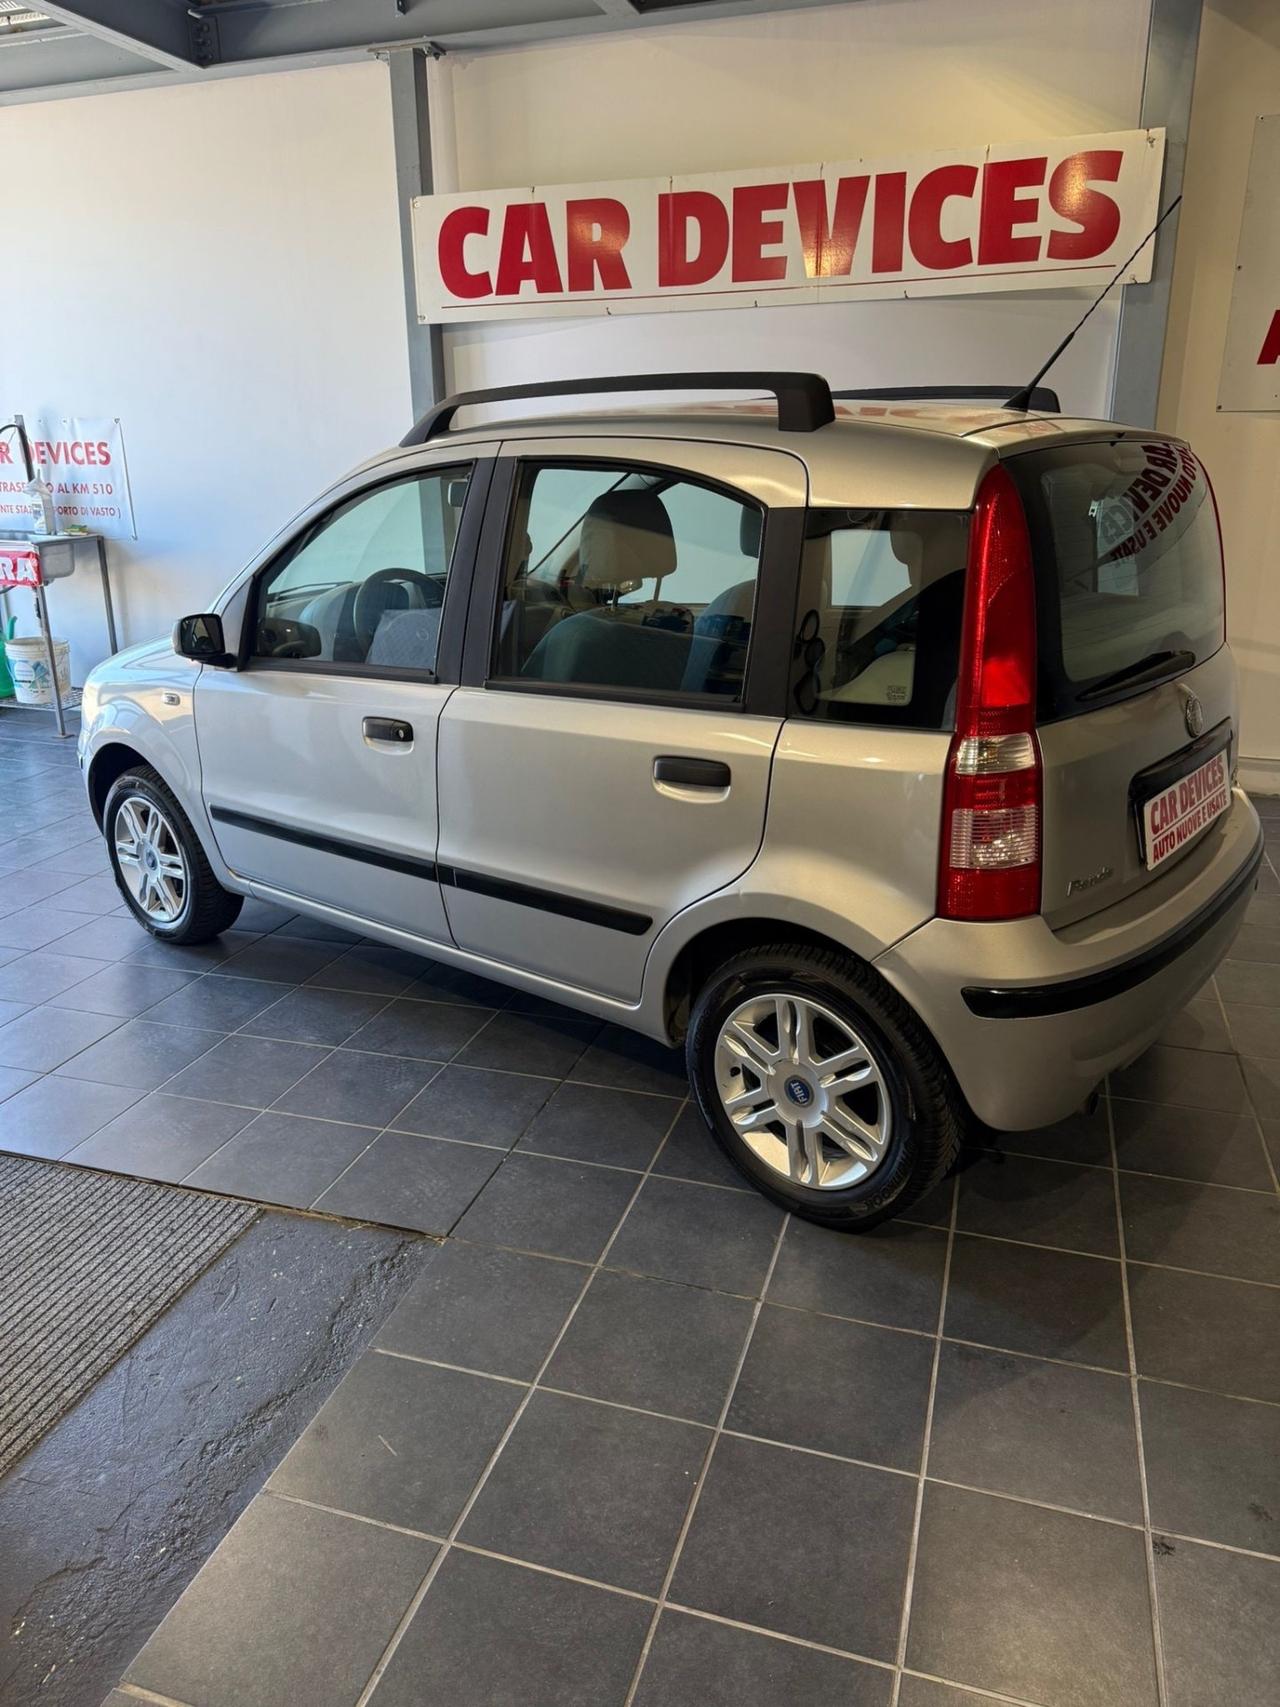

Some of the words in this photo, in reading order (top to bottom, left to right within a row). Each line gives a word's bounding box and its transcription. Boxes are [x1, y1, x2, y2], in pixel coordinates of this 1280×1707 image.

[437, 198, 632, 299] CAR
[657, 149, 1122, 288] DEVICES
[57, 483, 70, 494] AL
[72, 483, 90, 494] KM
[93, 483, 113, 495] 510
[90, 507, 116, 516] VASTO
[1150, 790, 1178, 835] CAR
[1178, 754, 1225, 814] DEVICES
[1152, 831, 1176, 863] AUTO
[1176, 811, 1201, 845] NUOVE
[1207, 789, 1228, 818] USATE
[789, 1081, 808, 1103] FIAT
